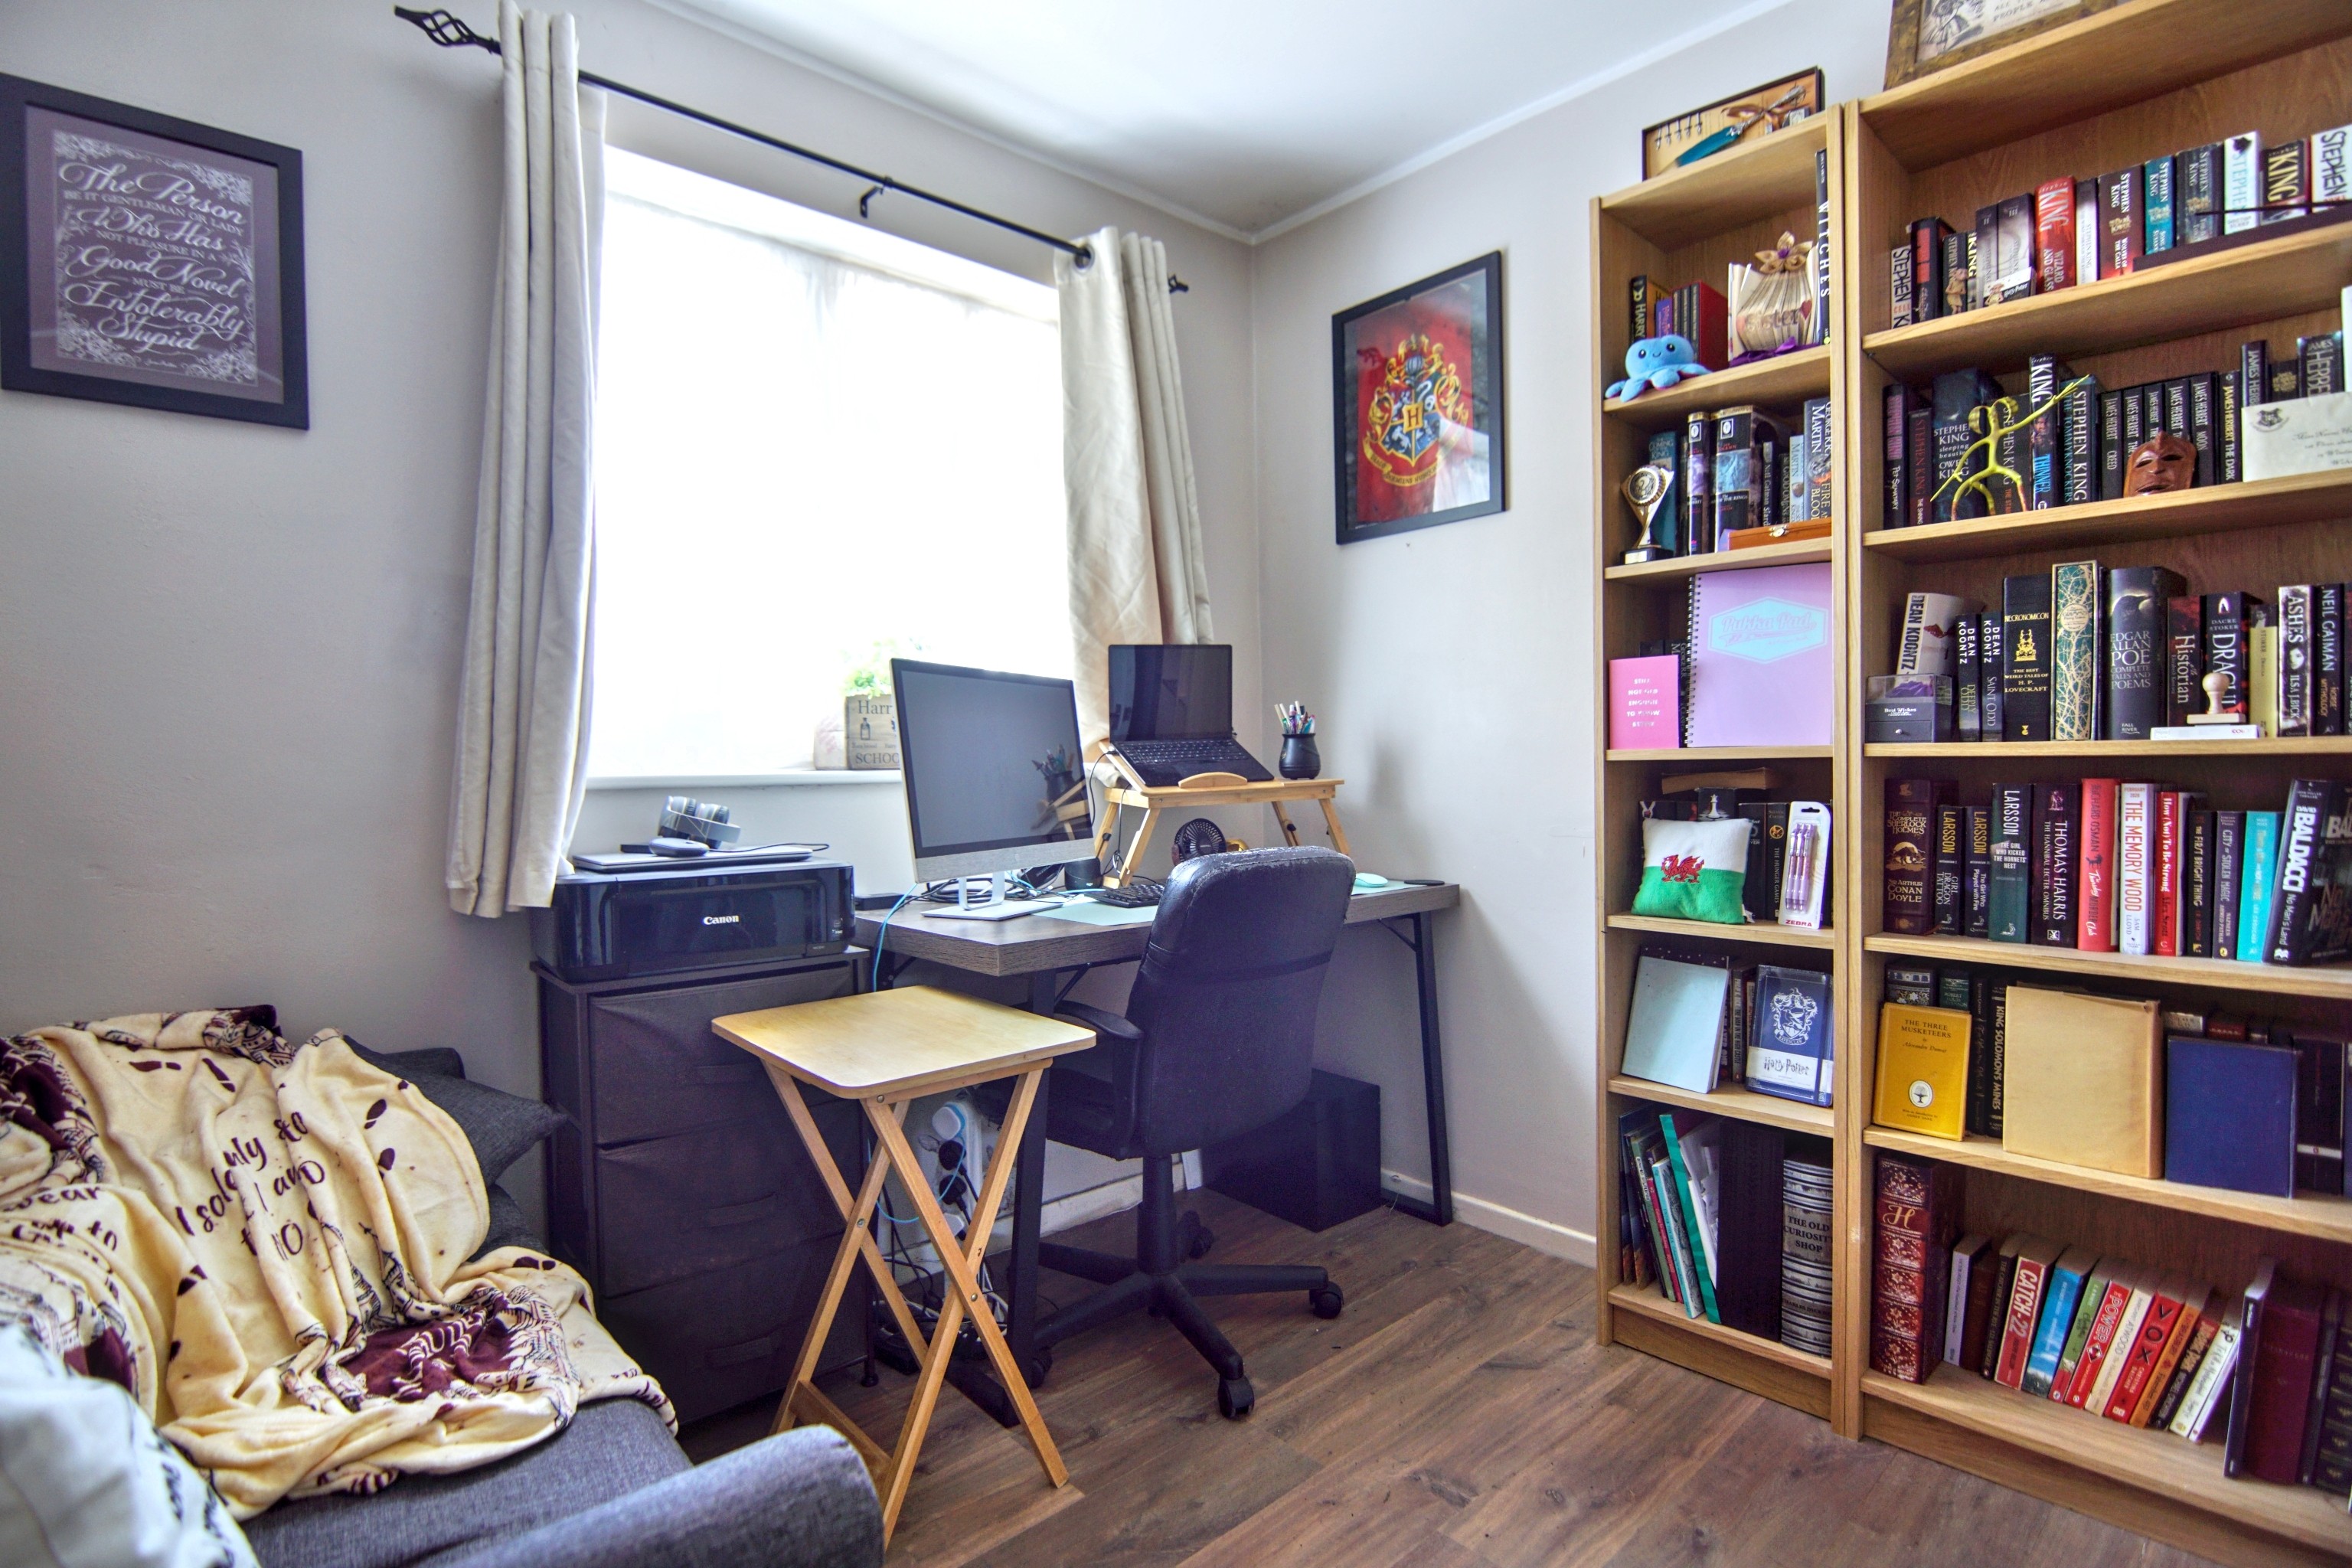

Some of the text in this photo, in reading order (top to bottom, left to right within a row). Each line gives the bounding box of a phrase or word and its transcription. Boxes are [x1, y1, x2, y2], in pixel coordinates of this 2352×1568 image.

[2188, 162, 2199, 187] KING
[2199, 152, 2209, 192] STEPHEN
[2268, 150, 2299, 203] KING
[2321, 130, 2348, 197] STEPHEN
[59, 162, 246, 224] The Person
[2111, 184, 2121, 208] KING
[2120, 172, 2131, 213] STEPHEN
[2149, 173, 2160, 197] KING
[2159, 162, 2170, 203] STEPHEN
[101, 193, 186, 217] GENTLEMAN
[2038, 186, 2069, 232] KING
[77, 206, 227, 251] Who Has
[127, 235, 189, 256] PLEASURE
[65, 244, 246, 299] Good Novel
[1893, 248, 1911, 303] STEPHEN
[2043, 248, 2055, 292] AND GLASS
[2054, 250, 2065, 283] WIZARD
[65, 280, 247, 341] Intolerably
[98, 312, 205, 354] Stupid
[2248, 350, 2259, 379] JAMES
[2030, 363, 2053, 403] KING
[1407, 407, 1419, 428] H
[2125, 395, 2139, 438] JAMES HERBERT
[2168, 386, 2184, 430] JAMES HERBERT
[2192, 382, 2208, 426] JAMES HERBERT
[1811, 404, 1825, 453] MARTIN
[1939, 433, 1970, 446] KING
[2105, 397, 2118, 470] JAMES HERBERT CREED
[2223, 385, 2236, 480] JAMES HERBERT THE DARK
[1792, 443, 1801, 477] MARTIN
[2073, 391, 2087, 501] STEPHEN KING
[2034, 453, 2052, 494] THINNER
[1821, 482, 1831, 508] FIRE
[1777, 612, 1812, 630] Pad
[1901, 595, 1926, 671] DEAN KOONTZ
[2004, 612, 2050, 622] NECRONOMICON
[2288, 595, 2305, 644] ASHES
[1958, 621, 1968, 665] KOONTZ
[1967, 628, 1975, 656] DEAN
[1992, 626, 2001, 655] DEAN
[2109, 640, 2151, 652] ALLAN
[2110, 630, 2151, 642] EDGAR
[2322, 620, 2335, 671] GAIMAN
[2110, 665, 2150, 674] COMPLETE
[2111, 648, 2151, 667] POE
[2175, 634, 2196, 704] Historian
[1961, 687, 1970, 710] ODD
[1967, 684, 1975, 713] DEEPLY
[2111, 678, 2151, 690] POEMS
[1985, 676, 1998, 727] SAINT ODD
[2003, 790, 2020, 836] LARSSON
[1942, 812, 1956, 854] LARSSON
[1973, 812, 1987, 854] LARSSON
[2090, 821, 2100, 852] OSMAN
[2160, 798, 2172, 893] How (Not) To Be Strong
[2223, 829, 2233, 847] CITY
[2125, 801, 2143, 913] THE MEMORY WOOD
[2221, 854, 2232, 879] STOLEN
[2282, 813, 2317, 893] BALDACCI
[2053, 820, 2067, 921] THOMAS HARRIS
[1887, 885, 1922, 894] CONAN
[1887, 893, 1922, 903] DOYLE
[1936, 871, 1945, 905] TATTOO
[2194, 882, 2203, 906] THING
[2220, 880, 2231, 902] MAGIC
[703, 915, 740, 926] Canon
[2042, 891, 2050, 920] OMNIBUS
[2278, 893, 2295, 946] No Land
[1785, 919, 1812, 927] ZEBRA
[2086, 921, 2097, 936] Club
[1901, 1025, 1952, 1039] MUSKETEERS
[1905, 1019, 1949, 1031] THE THREE
[1763, 1057, 1809, 1075] Harry Potter
[1991, 1005, 2005, 1110] KING MINES
[1787, 1215, 1830, 1232] THE OLD
[1882, 1204, 1916, 1230] H
[1795, 1240, 1823, 1253] SHOP
[2009, 1268, 2038, 1338] CATCH-22
[2094, 1294, 2122, 1344] POWER
[2115, 1321, 2135, 1355] ATWOOD
